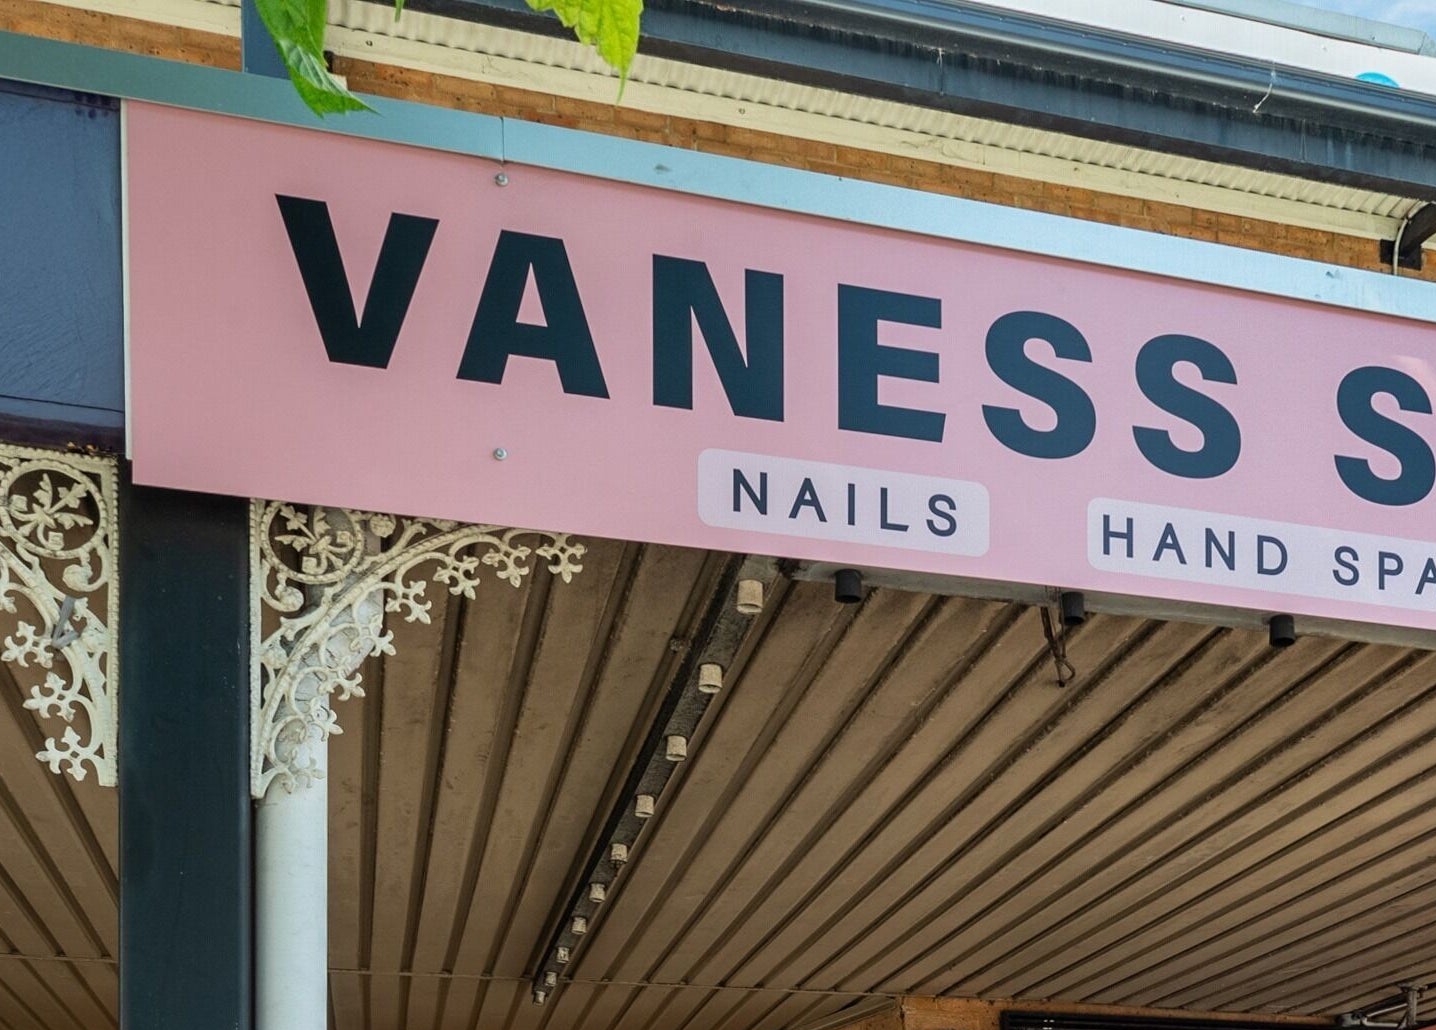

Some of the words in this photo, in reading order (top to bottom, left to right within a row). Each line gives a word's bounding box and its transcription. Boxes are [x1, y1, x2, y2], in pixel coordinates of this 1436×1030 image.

[275, 194, 1241, 479] VANESS
[733, 469, 956, 536] NAILS
[1103, 515, 1287, 575] HAND
